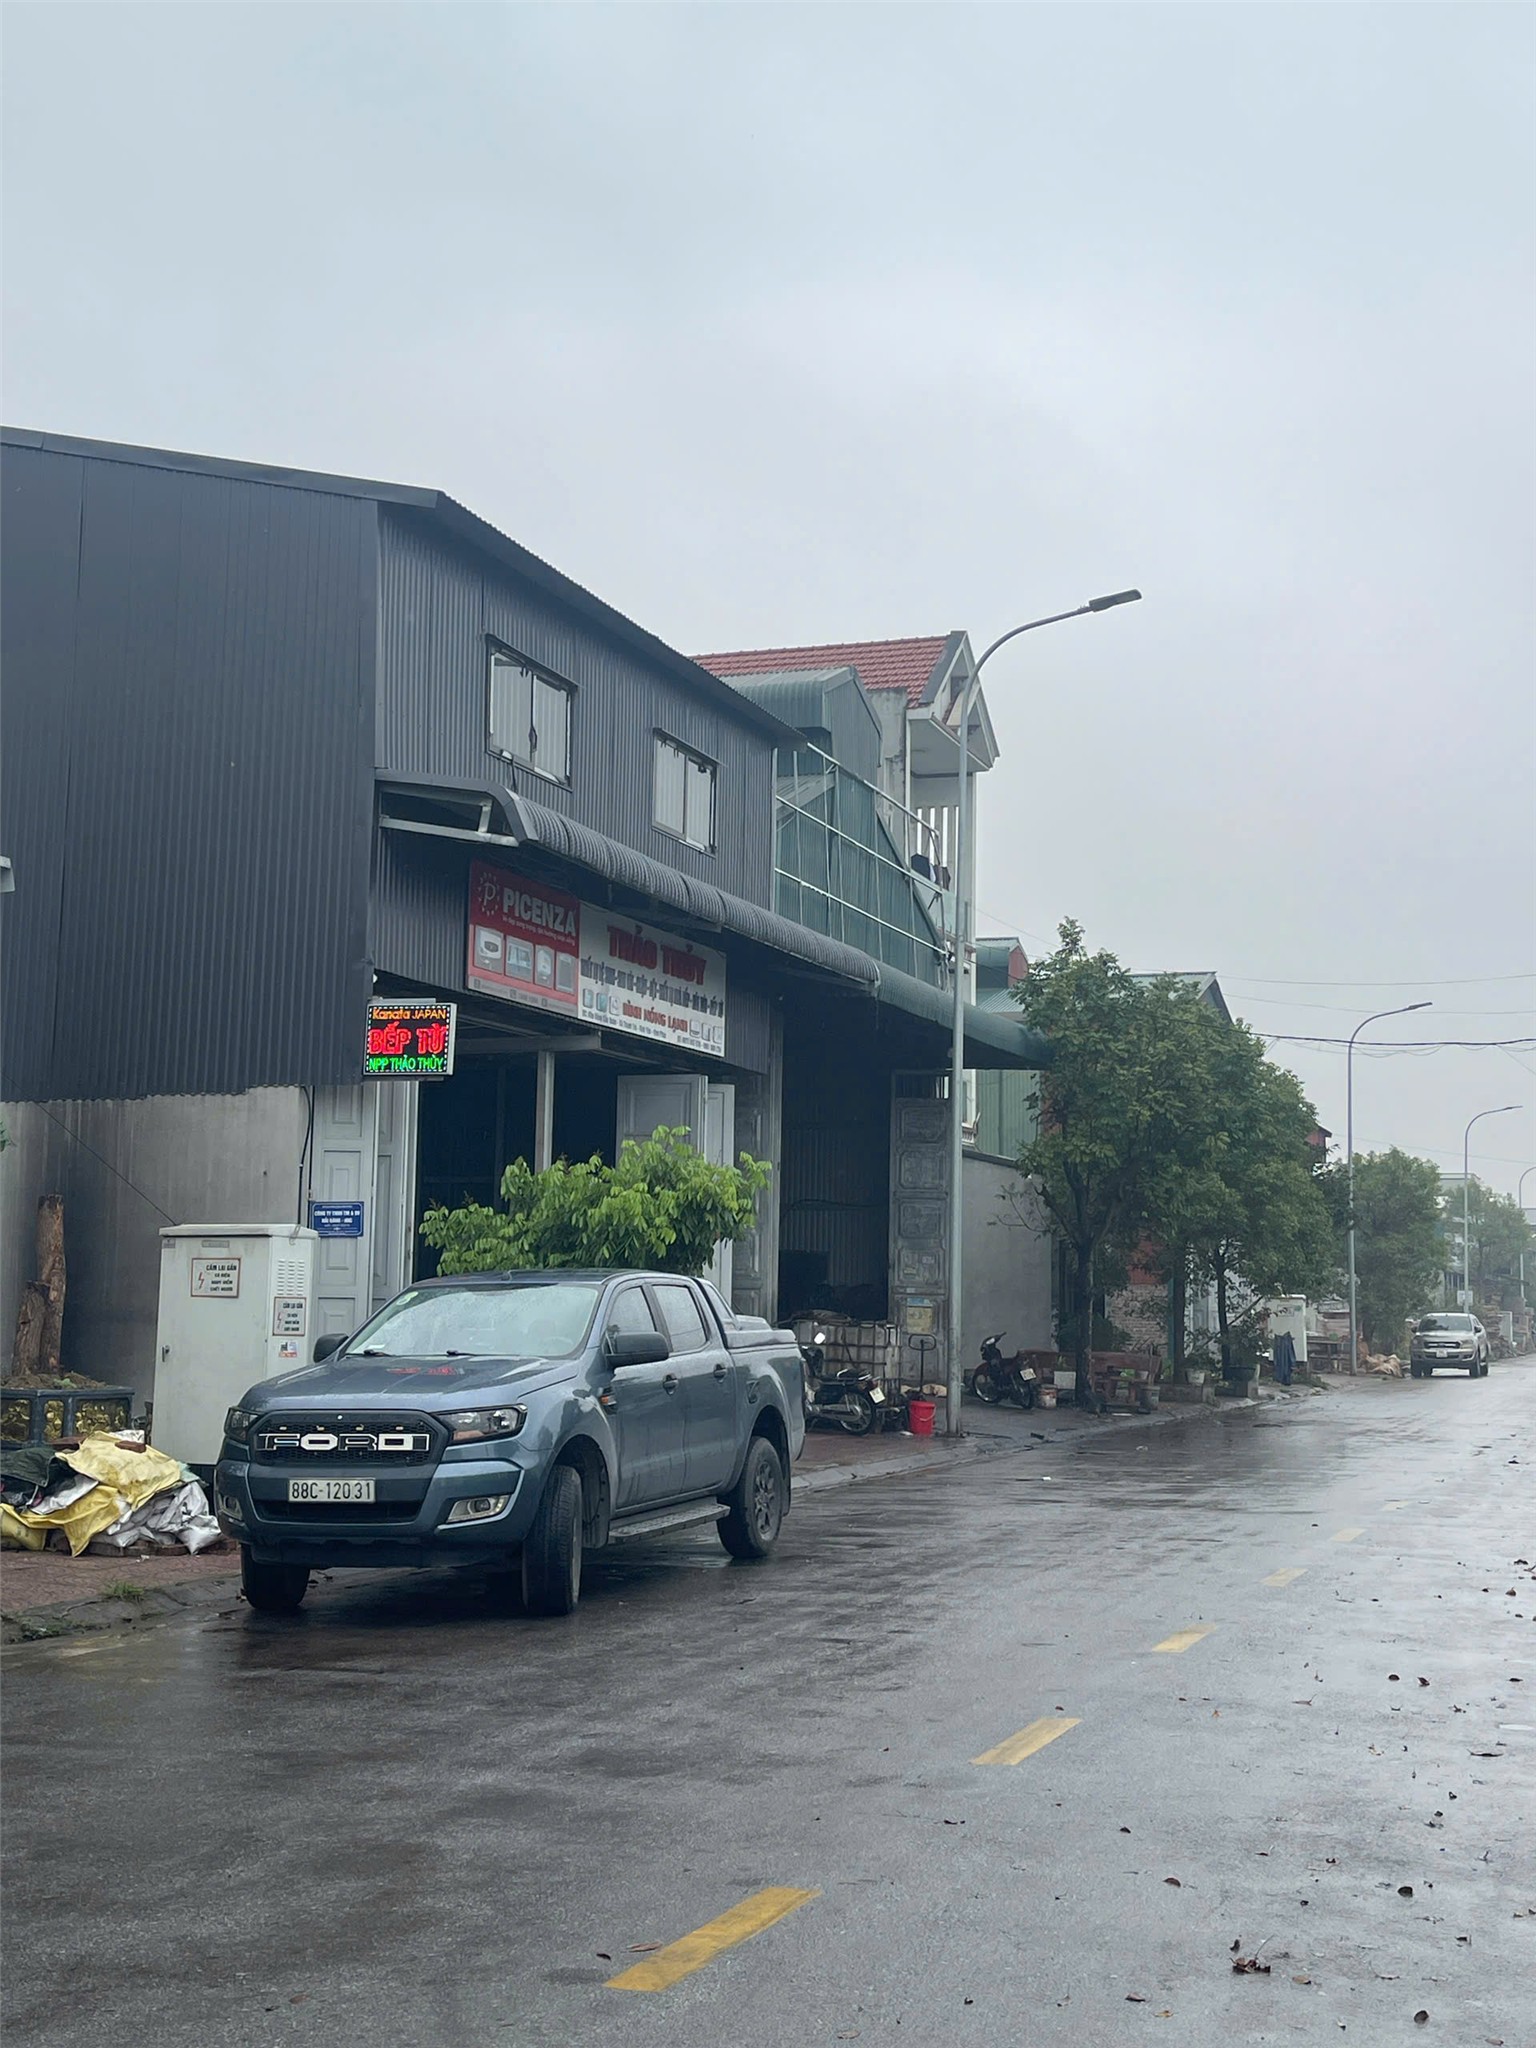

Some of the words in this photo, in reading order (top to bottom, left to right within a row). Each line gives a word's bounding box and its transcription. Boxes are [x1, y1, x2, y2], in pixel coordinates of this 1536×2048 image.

[503, 888, 577, 938] PICENZA
[411, 1008, 446, 1019] JAPAN
[644, 1006, 667, 1027] NÓNG
[368, 1021, 411, 1054] BẾP
[369, 1057, 389, 1071] NPP
[257, 1433, 431, 1451] FORD
